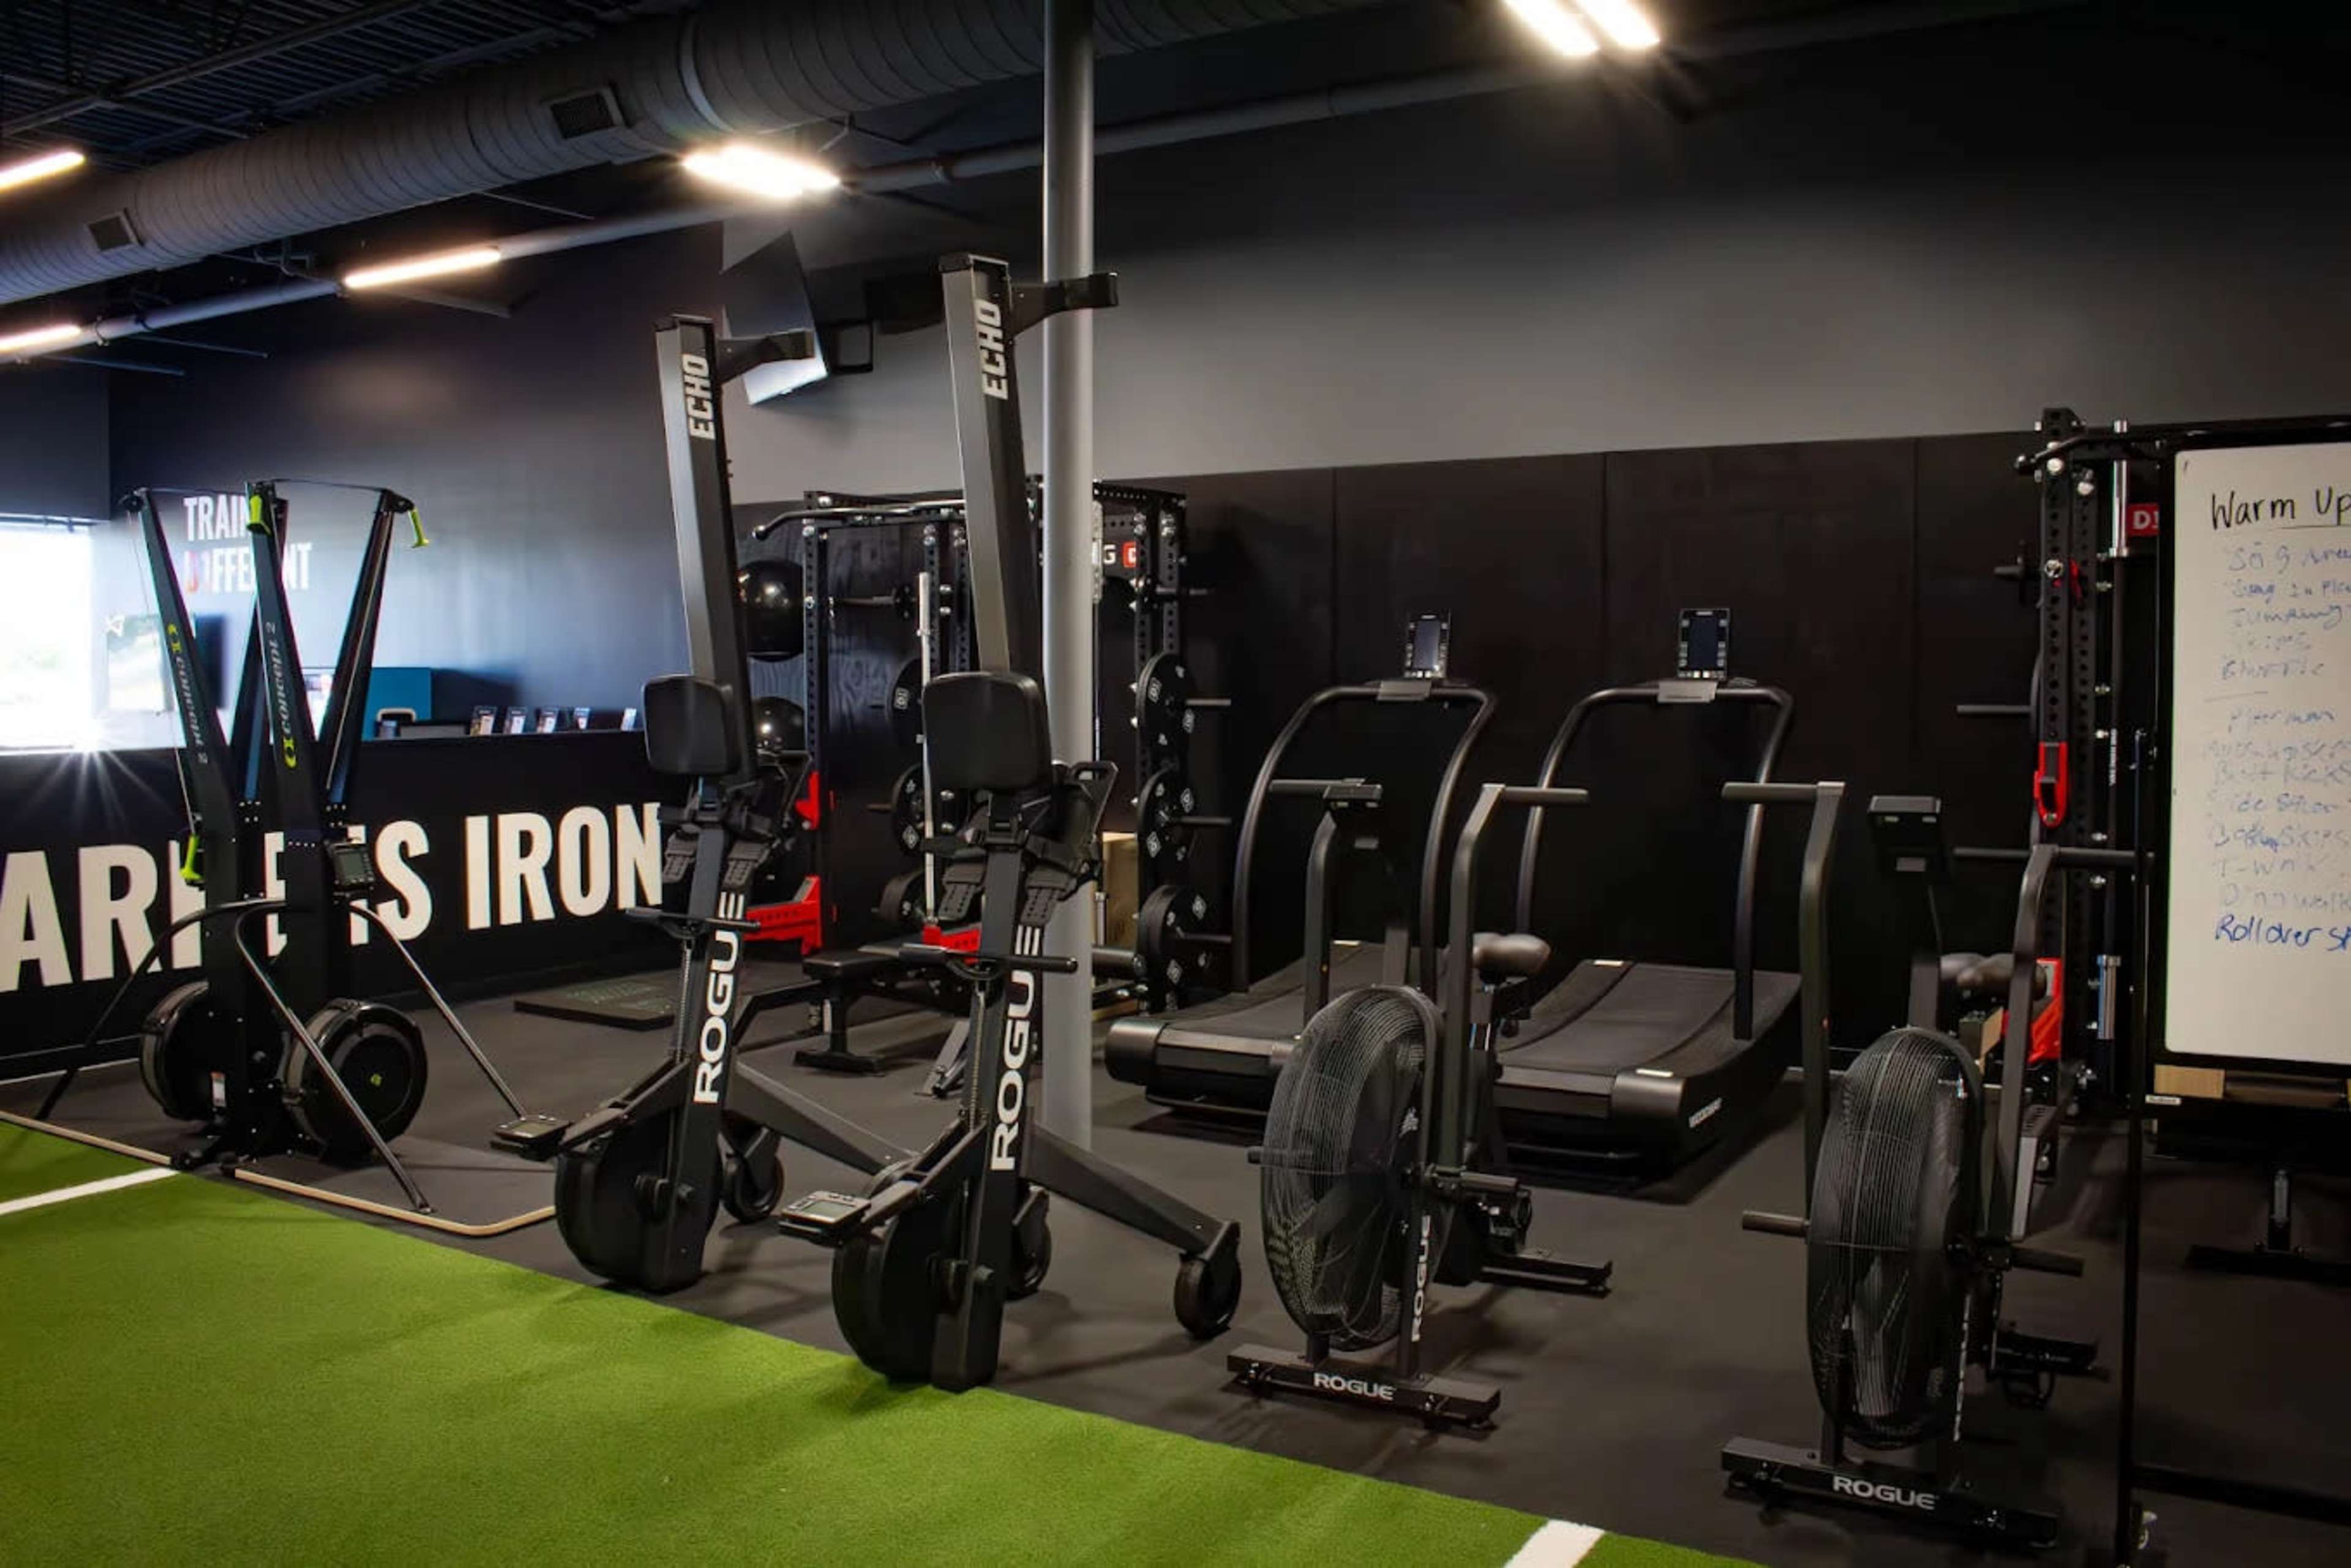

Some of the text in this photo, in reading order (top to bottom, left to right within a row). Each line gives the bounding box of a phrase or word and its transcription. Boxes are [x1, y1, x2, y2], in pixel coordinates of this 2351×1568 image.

[974, 298, 1009, 400] ECHO
[681, 353, 716, 440] ECHO
[2211, 490, 2296, 531] Warm
[464, 801, 662, 930] IRON
[693, 891, 744, 1105] ROGUE
[990, 925, 1042, 1171] ROGUE
[1313, 1372, 1395, 1401] ROGUE
[1831, 1474, 1937, 1510] ROGUE
